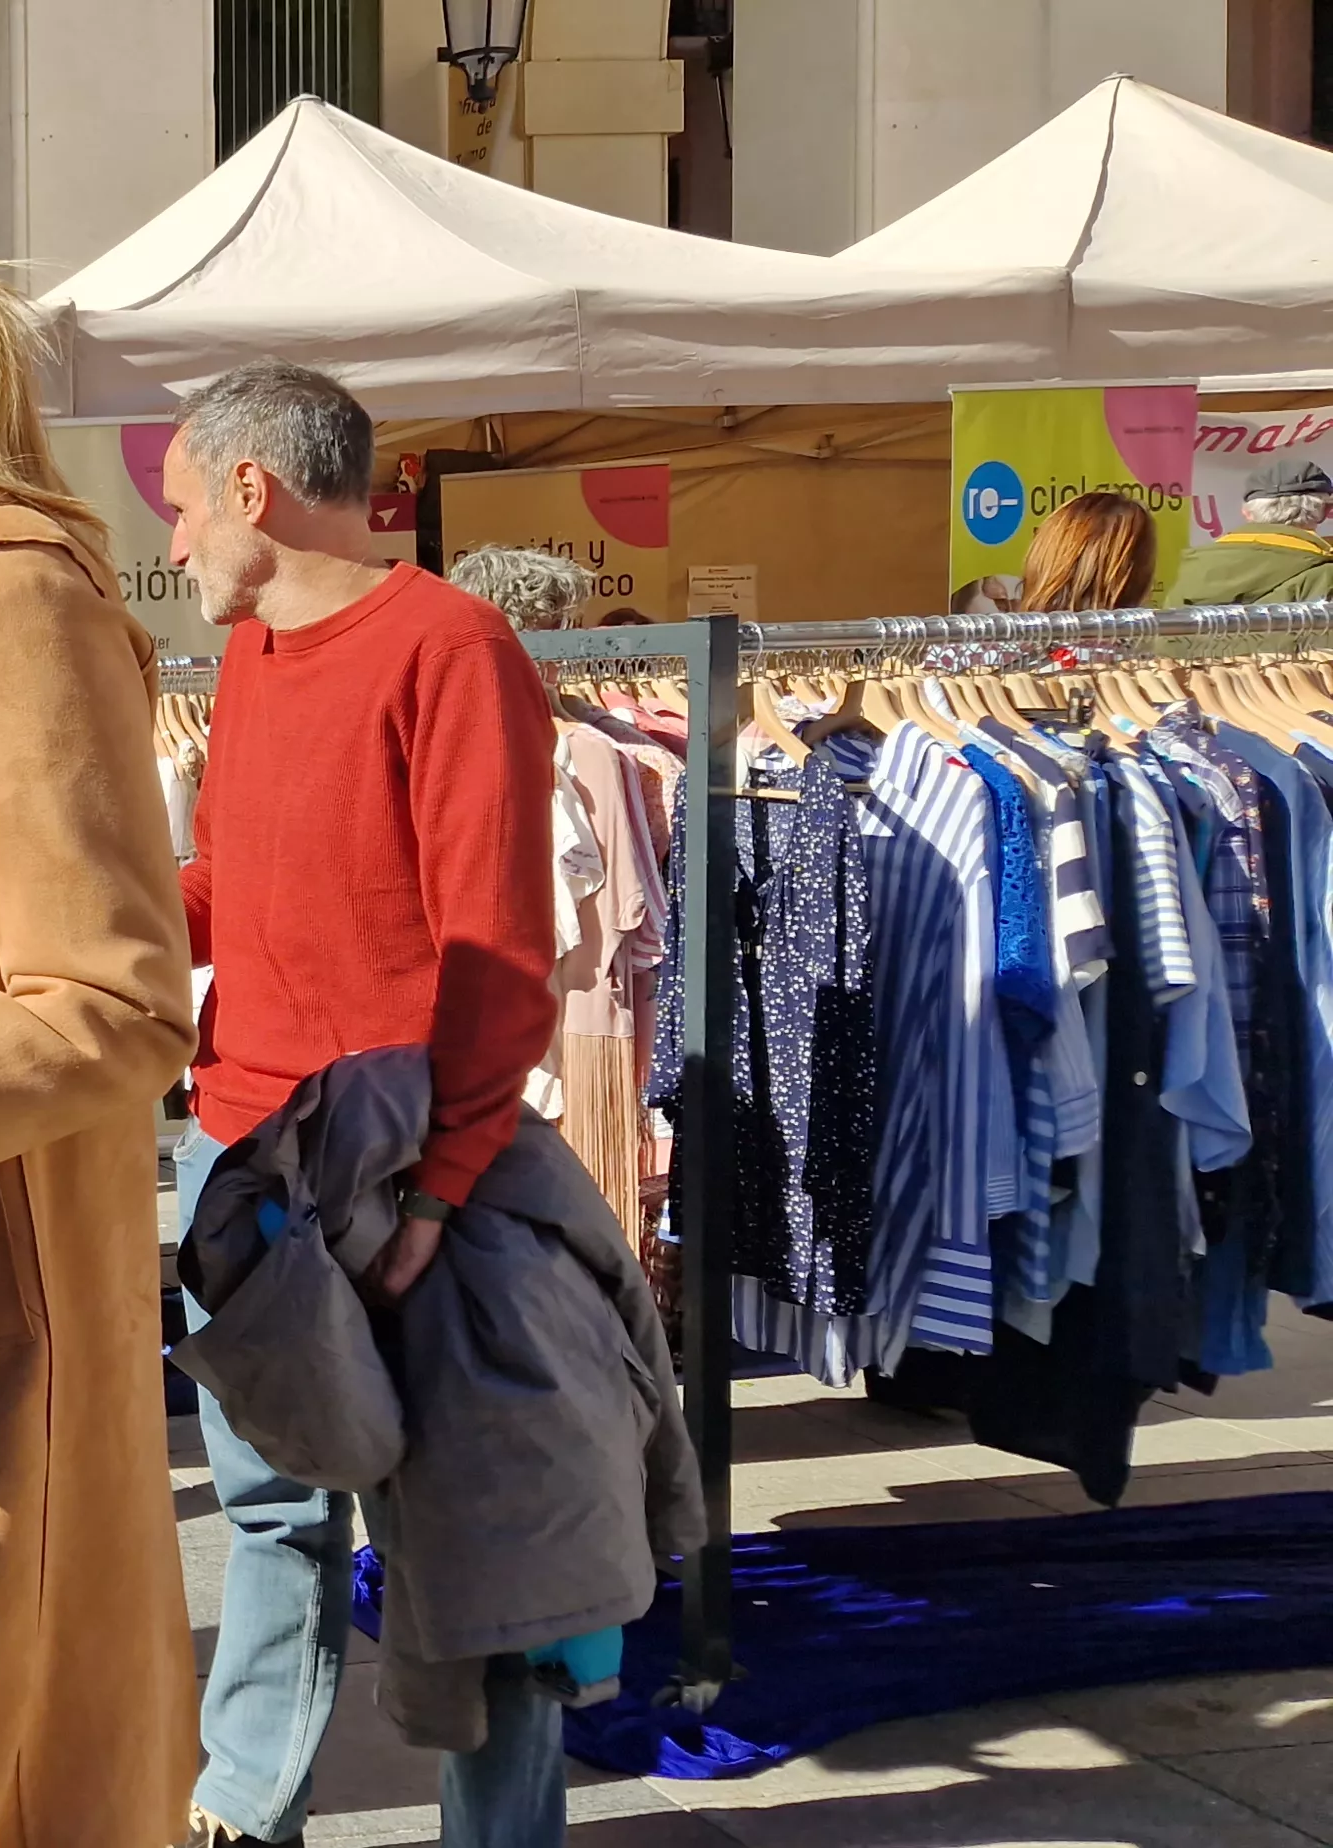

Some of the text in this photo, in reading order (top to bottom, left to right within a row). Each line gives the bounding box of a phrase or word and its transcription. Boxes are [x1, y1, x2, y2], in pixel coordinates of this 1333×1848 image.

[476, 116, 493, 136] de
[967, 486, 1019, 520] re-
[589, 540, 605, 569] y
